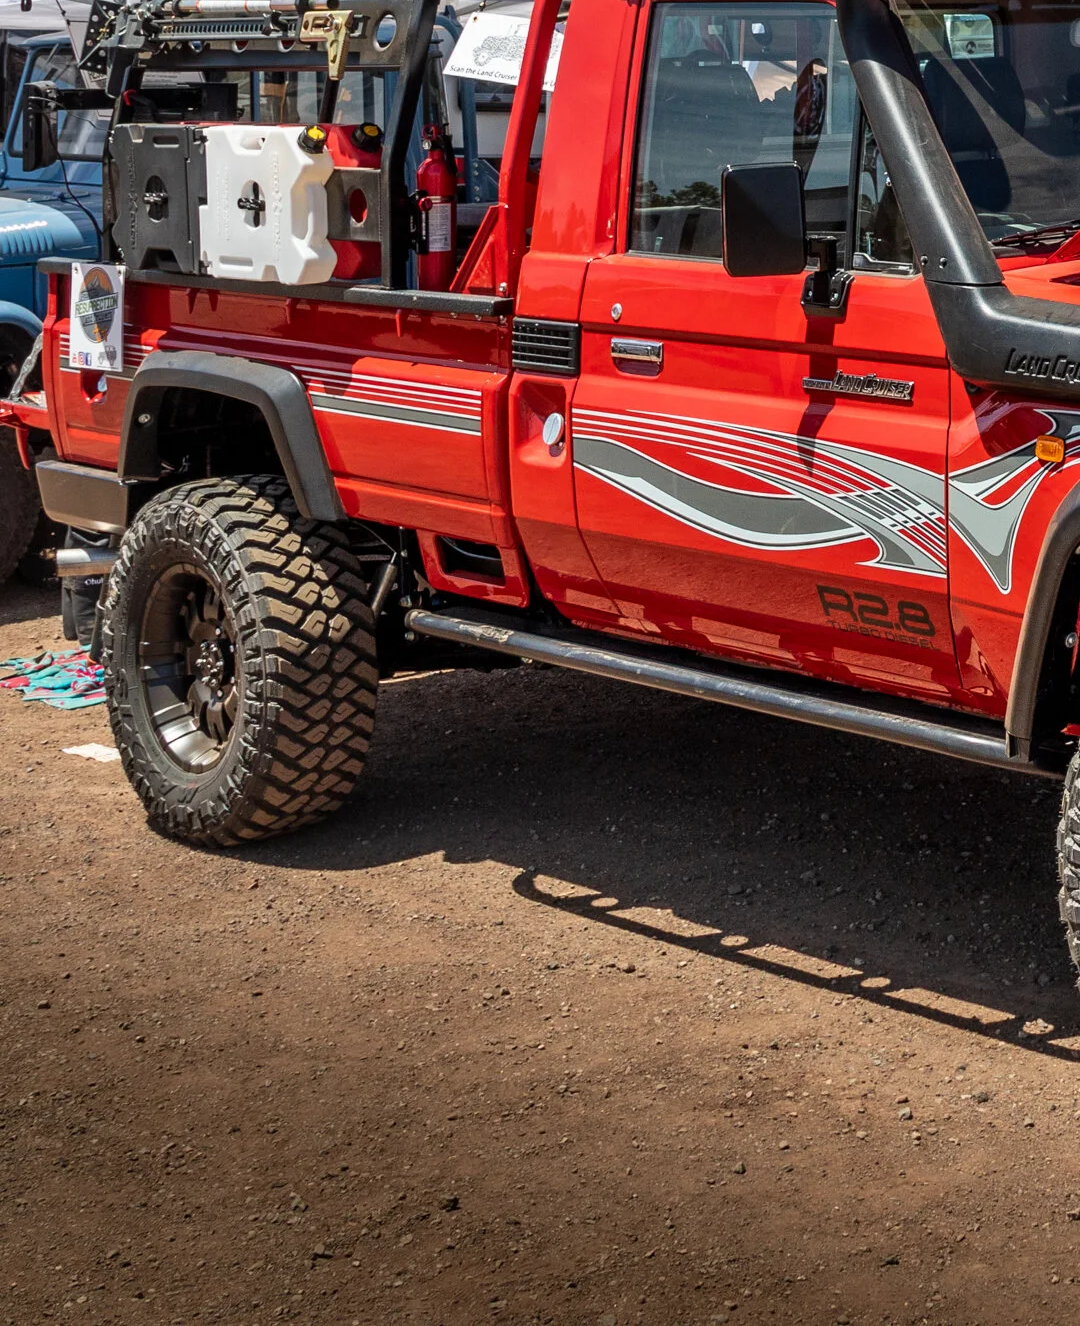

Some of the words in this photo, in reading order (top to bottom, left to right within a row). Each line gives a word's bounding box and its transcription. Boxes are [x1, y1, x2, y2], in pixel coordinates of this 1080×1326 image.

[450, 65, 465, 73] Scan
[465, 67, 476, 75] the
[477, 69, 494, 77] Land
[494, 71, 518, 80] Cruiser
[816, 583, 936, 637] R2.8
[826, 619, 880, 638] TURBO
[884, 631, 942, 652] DIESEL
